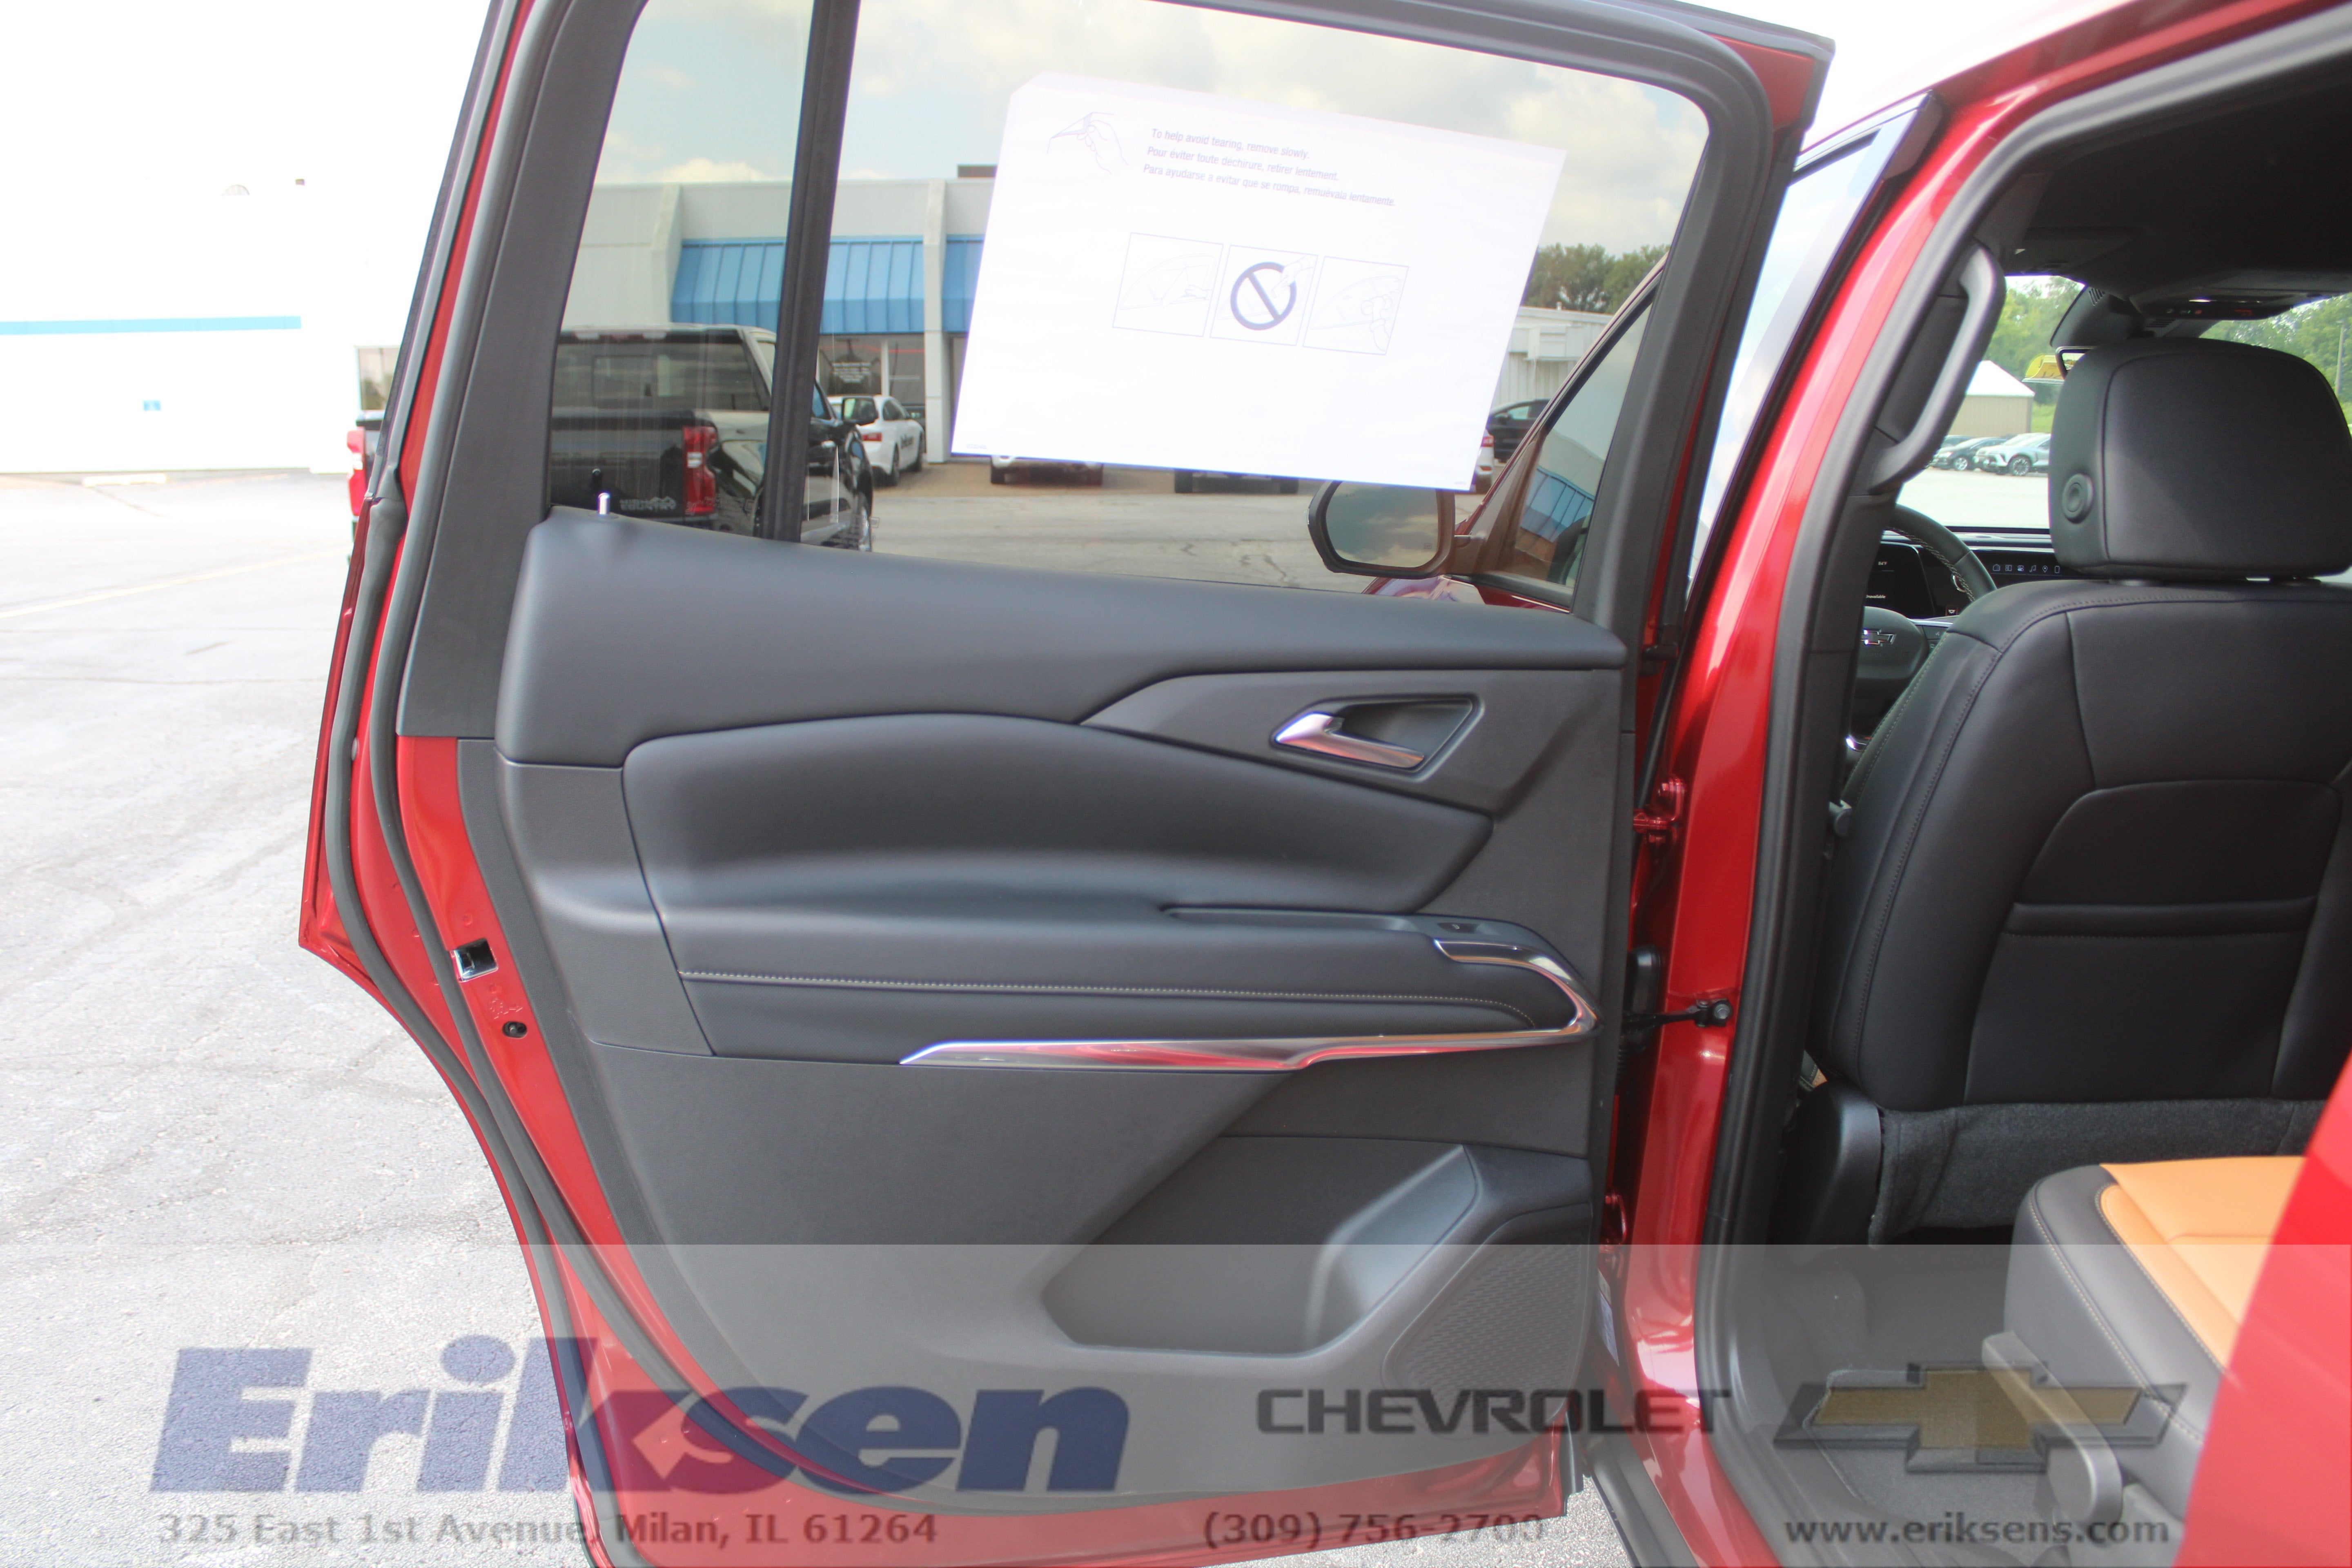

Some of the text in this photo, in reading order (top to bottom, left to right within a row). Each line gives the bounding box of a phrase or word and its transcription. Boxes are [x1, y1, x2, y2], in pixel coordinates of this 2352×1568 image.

[1152, 128, 1309, 160] To help avoid tearing, remove slowly.
[1147, 146, 1338, 181] Pour éviter toute déchirure, retirer lentement.
[1143, 164, 1163, 175] Para
[1165, 169, 1205, 180] ayudarse
[1216, 176, 1241, 185] evitar
[1242, 179, 1258, 188] que
[1272, 183, 1301, 195] rompa,
[1303, 187, 1347, 200] remuévala
[1349, 192, 1395, 206] lentamente.
